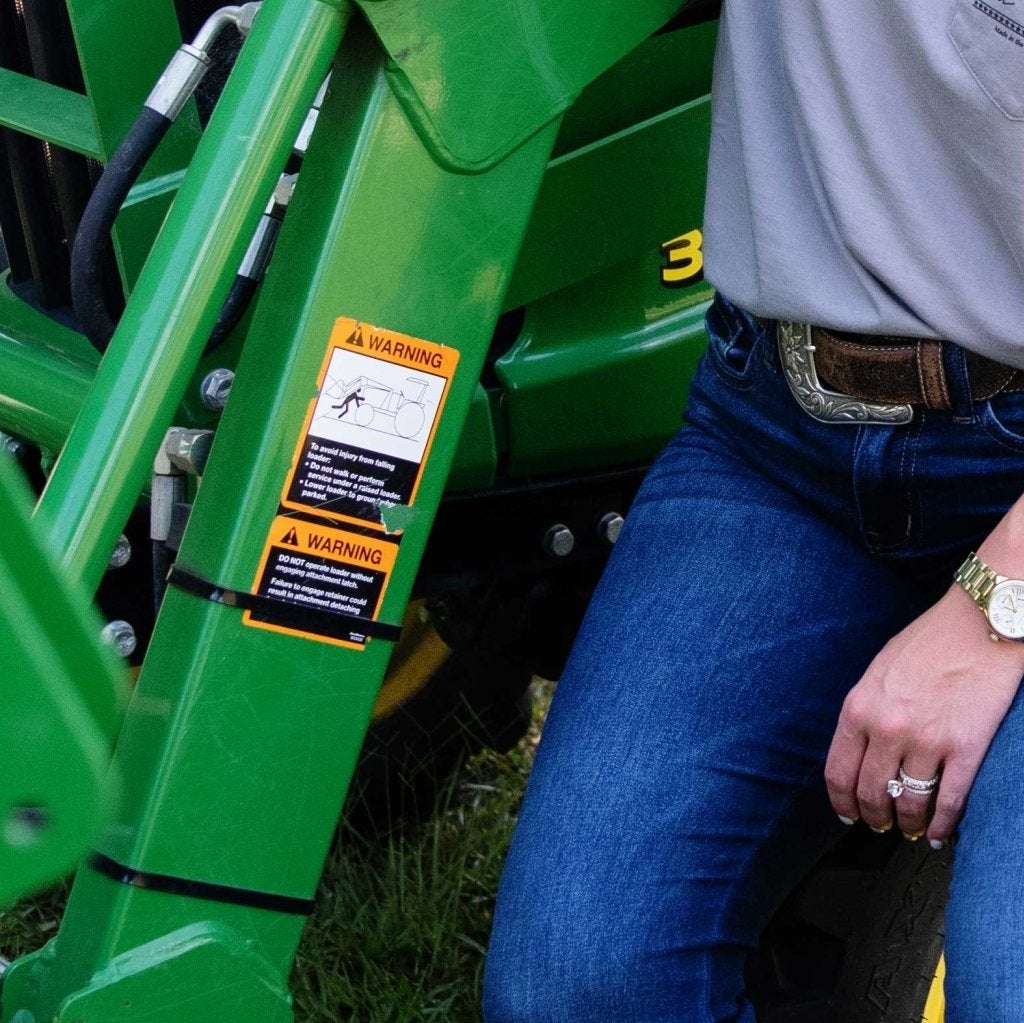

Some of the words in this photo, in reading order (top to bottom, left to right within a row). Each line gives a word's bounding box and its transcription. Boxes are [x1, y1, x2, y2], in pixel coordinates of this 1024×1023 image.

[995, 26, 1008, 38] Made
[1015, 39, 1023, 47] the
[368, 334, 444, 370] WARNING
[307, 452, 331, 463] loader:
[311, 442, 319, 450] To
[320, 447, 339, 455] avoid
[339, 450, 358, 461] injury
[359, 455, 374, 464] from
[375, 460, 395, 471] falling
[308, 472, 332, 482] service
[333, 479, 352, 487] under
[359, 485, 379, 494] raised
[310, 462, 320, 470] Do
[334, 469, 349, 477] walk
[358, 476, 384, 486] perform
[302, 490, 326, 500] parked.
[305, 480, 326, 490] Lower
[326, 485, 348, 495] loader
[306, 532, 384, 565] WARNING
[276, 565, 305, 577] engaging
[306, 572, 341, 584] attachment
[341, 579, 358, 588] latch.
[279, 554, 290, 562] DO
[290, 557, 305, 566] NOT
[305, 562, 329, 572] operate
[330, 567, 350, 576] loader
[351, 573, 373, 582] without
[268, 588, 287, 596] result
[294, 594, 330, 606] attachment
[330, 602, 360, 615] detaching
[271, 578, 292, 588] Failure
[301, 586, 324, 596] engage
[325, 592, 349, 601] retainer
[349, 597, 367, 605] could
